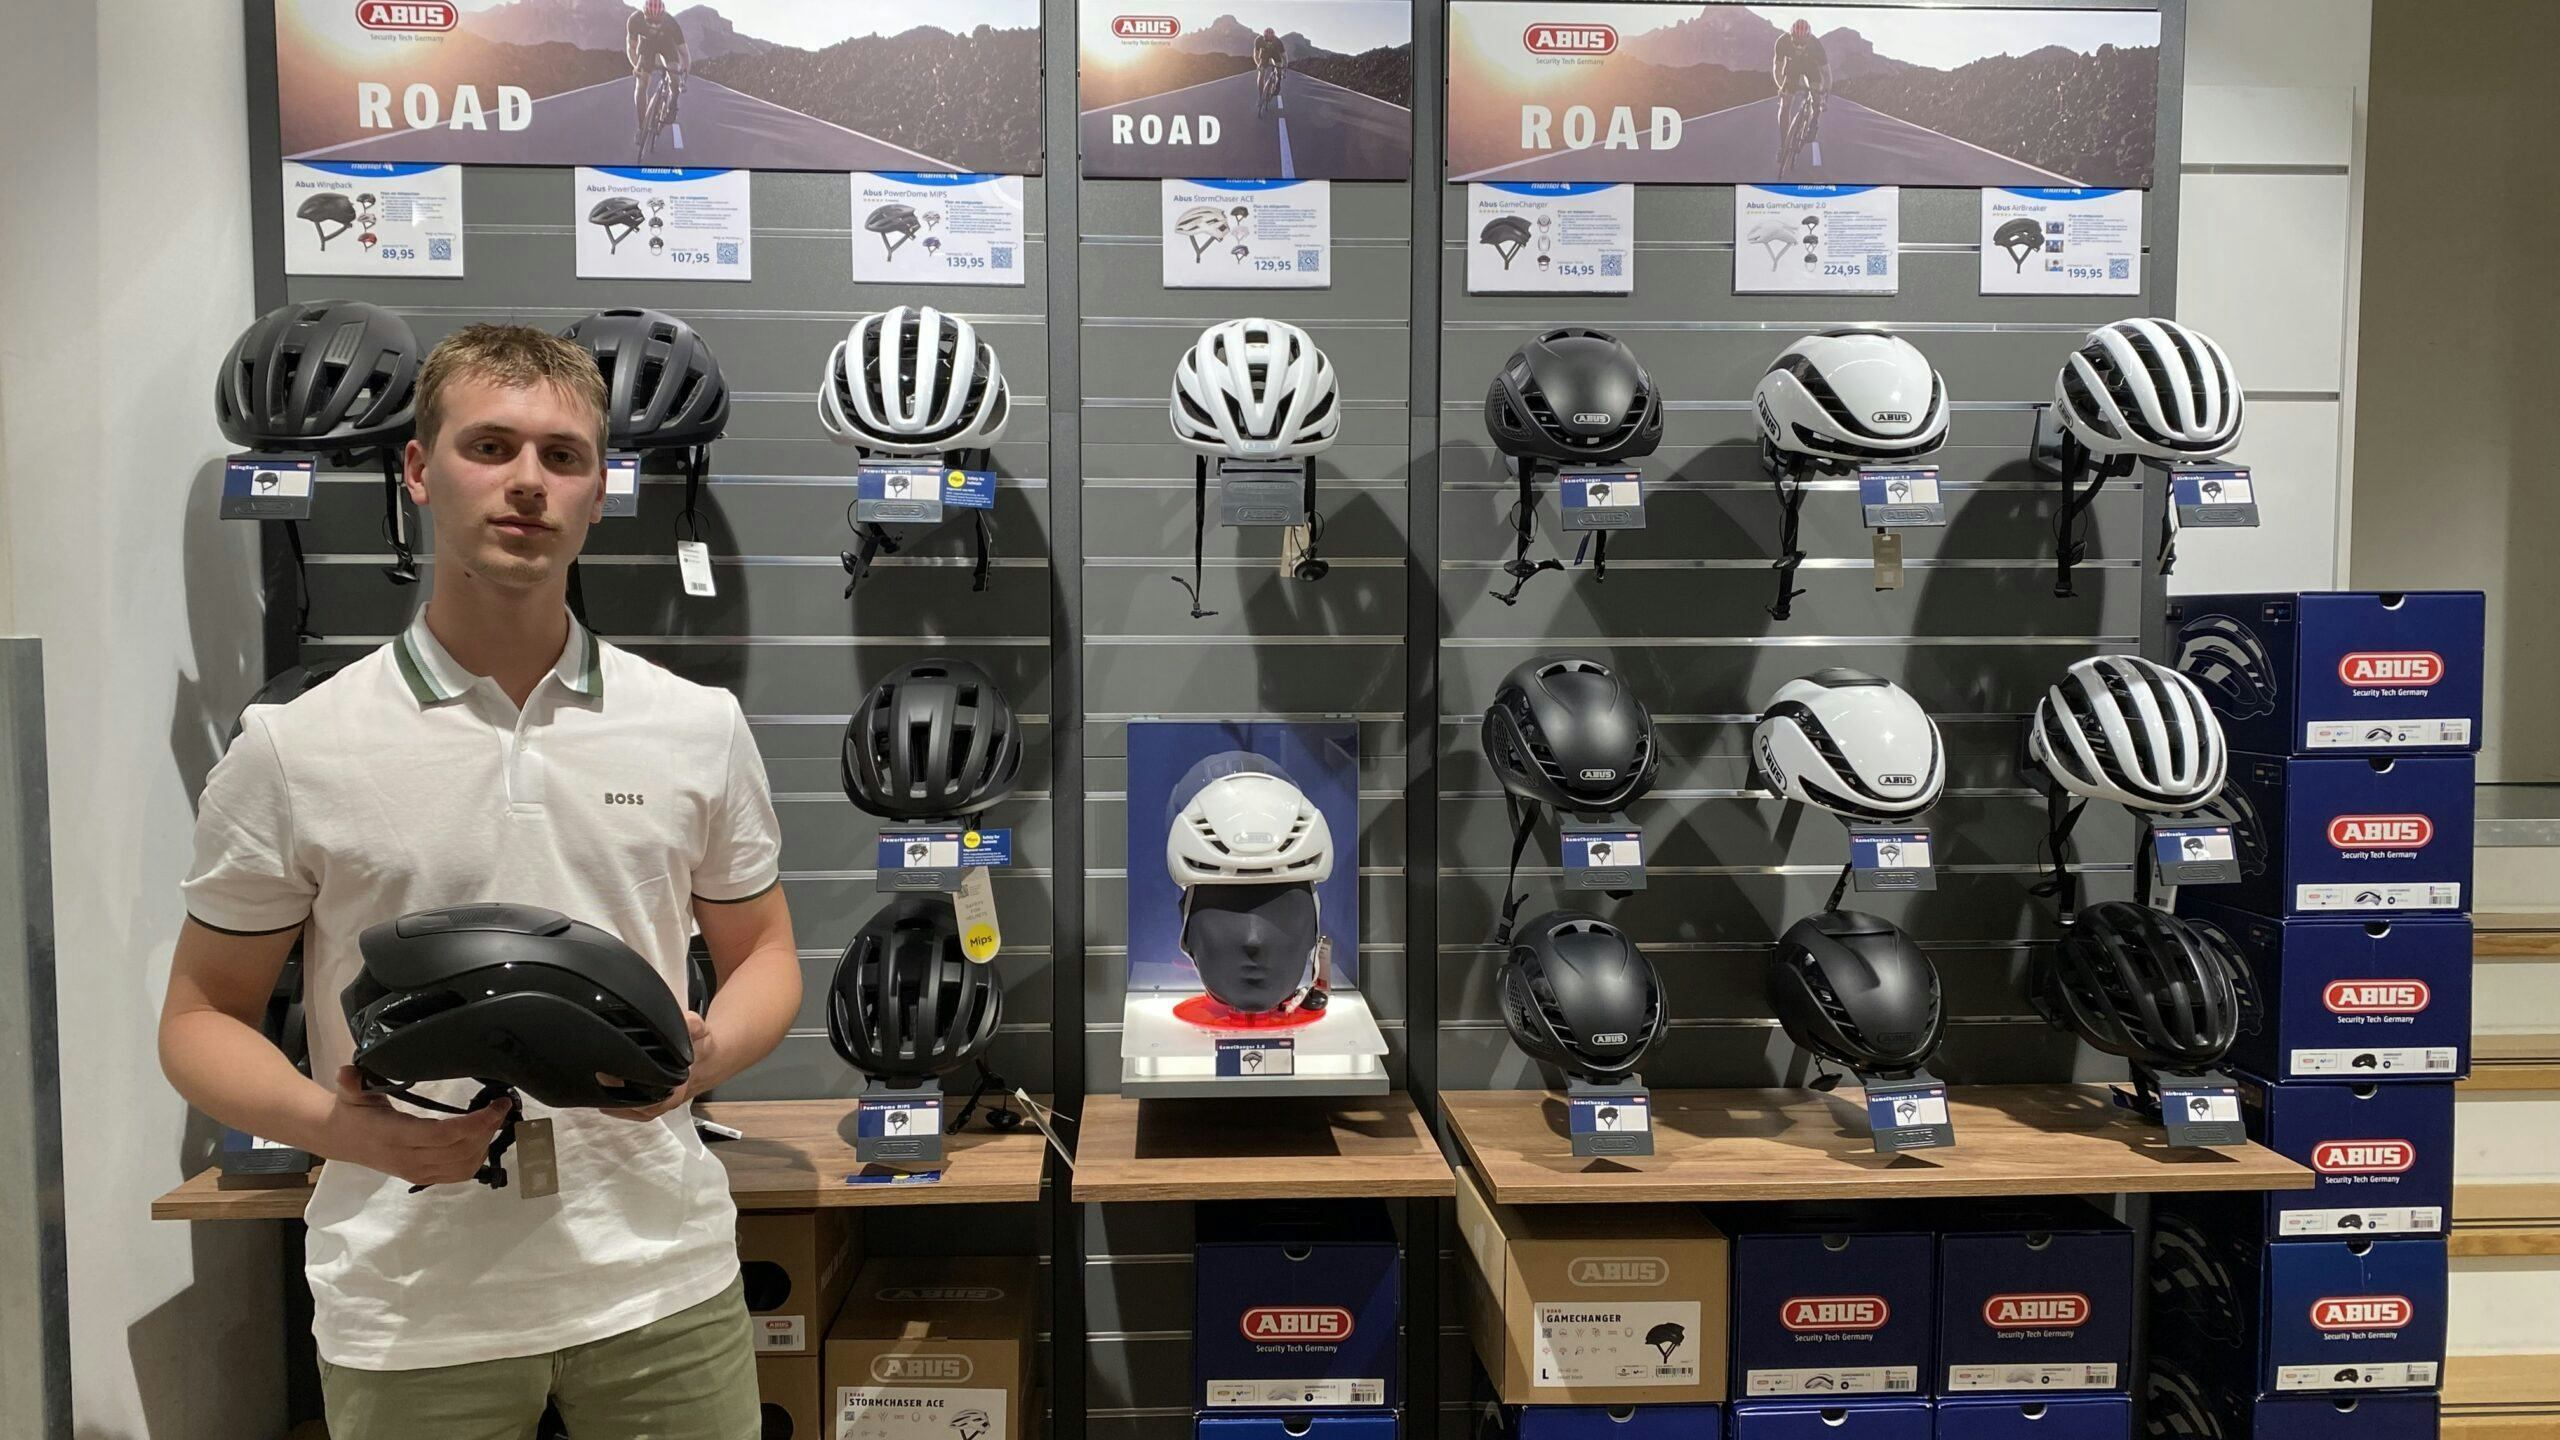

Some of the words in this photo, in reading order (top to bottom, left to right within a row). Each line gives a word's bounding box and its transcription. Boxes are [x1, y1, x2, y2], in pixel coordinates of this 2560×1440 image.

[369, 5, 445, 25] ABUS
[1120, 20, 1171, 34] ABUS
[370, 33, 396, 41] Security
[415, 34, 444, 43] Germany
[1536, 31, 1605, 48] ABUS
[1536, 57, 1560, 65] Security
[1577, 58, 1604, 66] Germany
[358, 81, 532, 131] ROAD
[1112, 114, 1221, 145] ROAD
[1521, 104, 1683, 150] ROAD
[317, 181, 352, 190] Wingback
[608, 185, 652, 193] PowerDome
[1499, 201, 1548, 209] GameChanger
[1766, 202, 1814, 210] GameChanger
[382, 249, 415, 260] 89,95
[671, 253, 710, 264] 107,95
[946, 257, 984, 268] 139,95
[1254, 261, 1291, 272] 129,95
[1558, 265, 1594, 276] 154,95
[1824, 265, 1861, 277] 224,95
[2067, 268, 2102, 279] 199,95
[1758, 399, 1776, 436] ABUS
[2353, 660, 2429, 678] ABUS
[2353, 688, 2379, 698] Security
[2381, 688, 2396, 696] Tech
[2398, 688, 2428, 698] Germany
[1761, 744, 1783, 786] ABUS
[605, 792, 644, 805] BOSS
[2342, 823, 2418, 841] ABUS
[2342, 851, 2369, 860] Security
[2387, 851, 2417, 859] Germany
[970, 935, 993, 947] Mips
[2338, 987, 2415, 1005] ABUS
[2338, 1015, 2365, 1024] Security
[2367, 1015, 2381, 1023] Tech
[2384, 1015, 2414, 1024] Germany
[1597, 1035, 1624, 1043] ABUS
[2326, 1148, 2401, 1166] ABUS
[2325, 1176, 2352, 1185] Security
[2370, 1175, 2400, 1184] Germany
[1581, 1263, 1656, 1280] ABUS
[897, 1288, 990, 1299] ABUS
[1796, 1303, 1874, 1323] ABUS
[1998, 1301, 2076, 1320] ABUS
[2325, 1303, 2399, 1322] ABUS
[1256, 1314, 1338, 1333] ABUS
[1547, 1314, 1621, 1323] GAMECHANGER
[1795, 1334, 1822, 1343] Security
[1825, 1333, 1840, 1341] Tech
[1842, 1333, 1873, 1342] Germany
[1997, 1331, 2025, 1340] Security
[2026, 1330, 2041, 1338] Tech
[2043, 1330, 2074, 1339] Germany
[2324, 1332, 2350, 1341] Security
[2368, 1331, 2397, 1340] Germany
[1256, 1344, 1285, 1354] Security
[1305, 1345, 1338, 1354] Germany
[883, 1359, 961, 1378] ABUS
[1542, 1368, 1549, 1379] L
[850, 1398, 922, 1408] STORMCHASER
[926, 1400, 945, 1408] ACE
